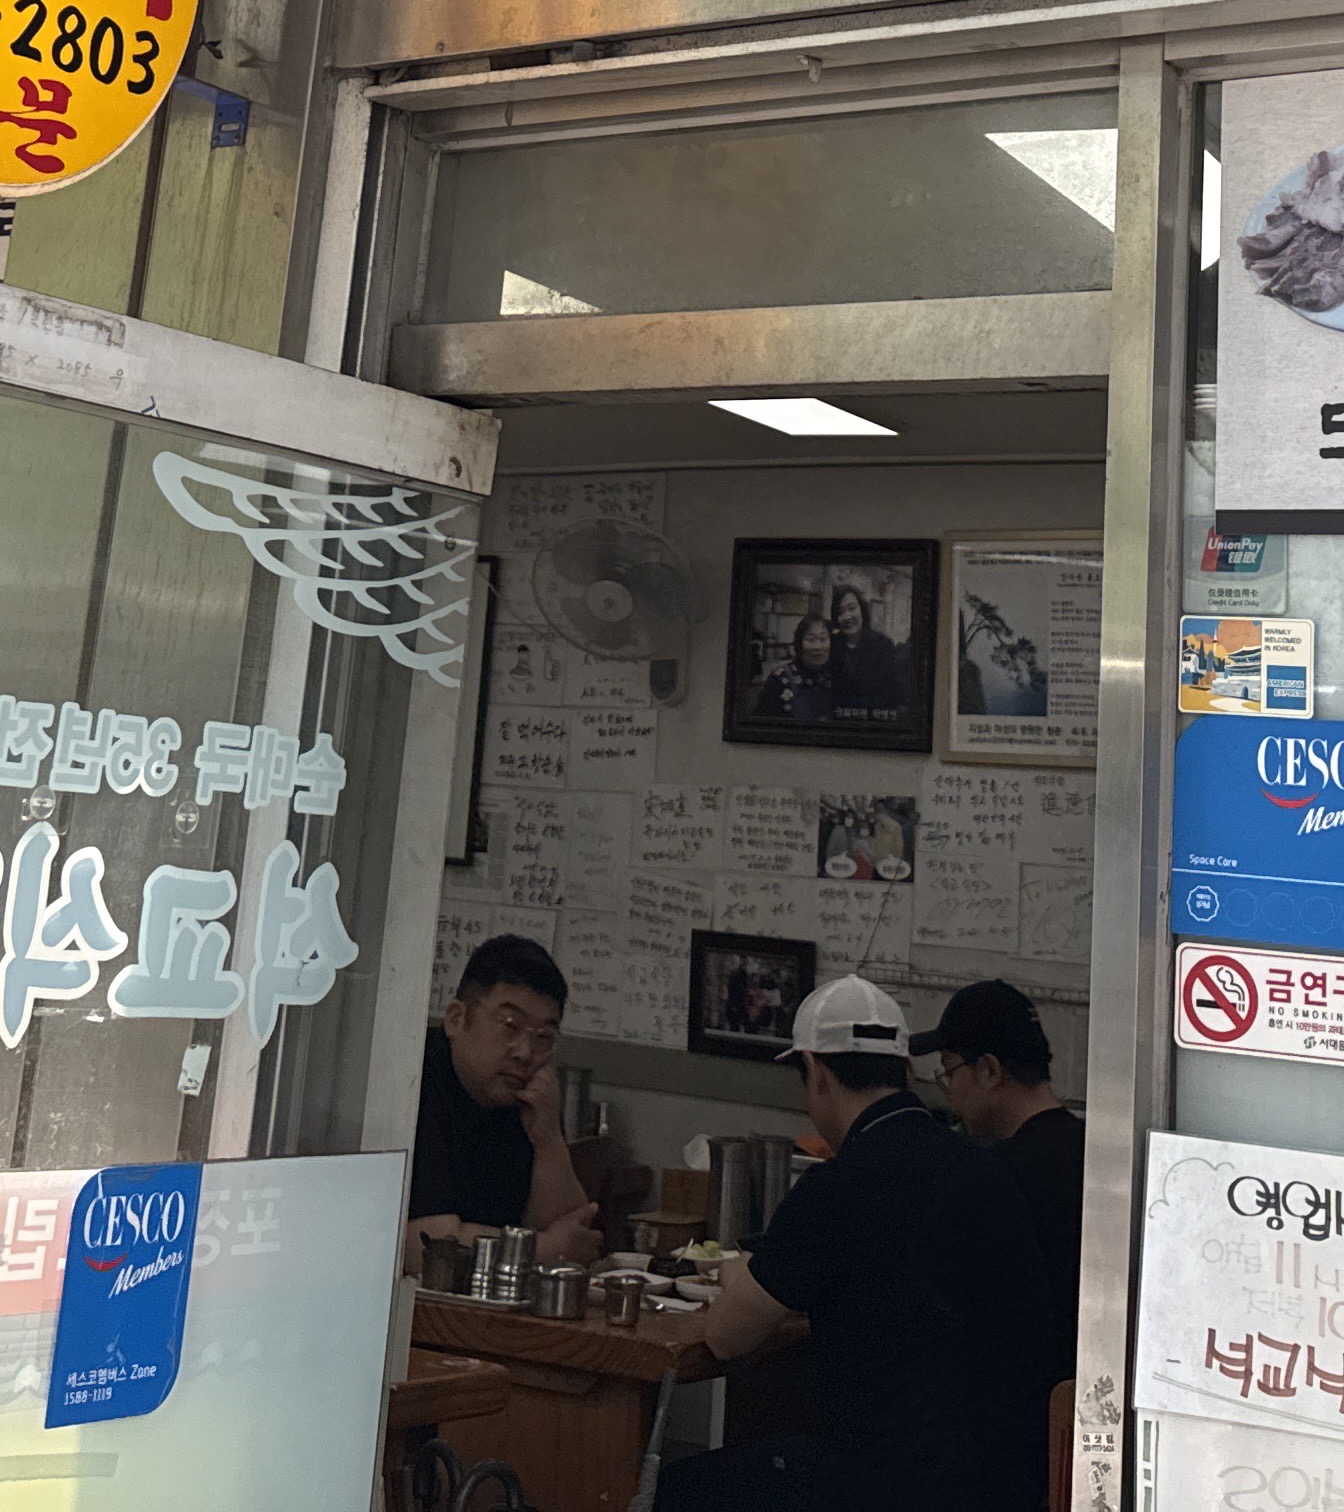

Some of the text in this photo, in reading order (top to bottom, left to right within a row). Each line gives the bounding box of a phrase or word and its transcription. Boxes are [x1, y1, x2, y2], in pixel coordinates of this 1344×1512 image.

[1207, 537, 1264, 555] UnionPay
[1189, 853, 1215, 867] Space
[1268, 1006, 1285, 1016] NO
[83, 1190, 186, 1250] CESCO
[108, 1248, 186, 1300] Members
[66, 1363, 157, 1390] 세스코멤버스 Zone
[64, 1386, 113, 1406] 1588-1119
